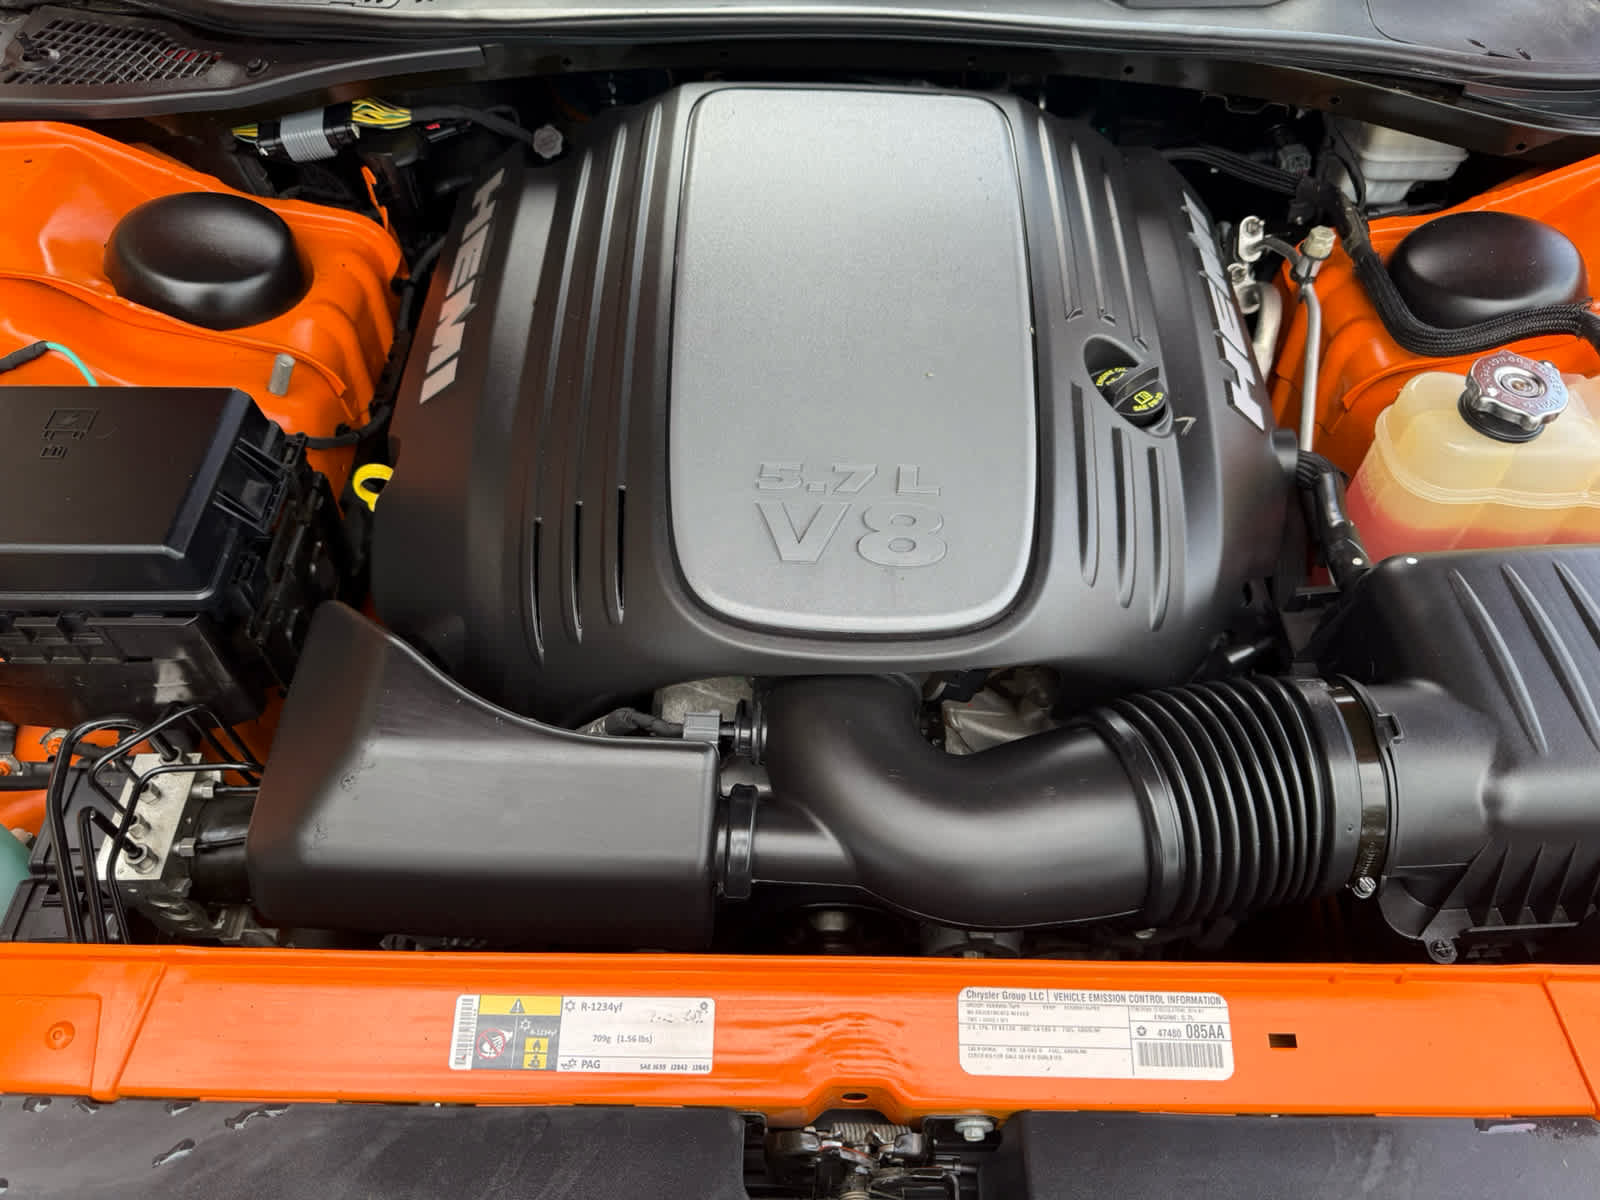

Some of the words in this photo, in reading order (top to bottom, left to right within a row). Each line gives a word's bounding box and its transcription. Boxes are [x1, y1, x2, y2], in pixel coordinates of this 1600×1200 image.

[419, 168, 505, 405] HEMI
[1183, 191, 1265, 432] HEMI
[753, 502, 948, 568] V8
[966, 989, 999, 1001] Chrysler
[1002, 991, 1026, 1002] Group
[1029, 991, 1045, 1001] LLC
[1053, 992, 1087, 1002] VEHICLE
[1089, 993, 1126, 1003] EMISSION
[1128, 994, 1165, 1004] CONTROL
[1167, 995, 1222, 1005] INFORMATION
[581, 1001, 623, 1013] R-1234yf
[1186, 1023, 1225, 1039] 085AA
[592, 1034, 612, 1044] 709g
[617, 1034, 637, 1044] (1.56
[638, 1033, 653, 1044] lbs)
[581, 1059, 601, 1069] PAG
[640, 1063, 651, 1071] SAE
